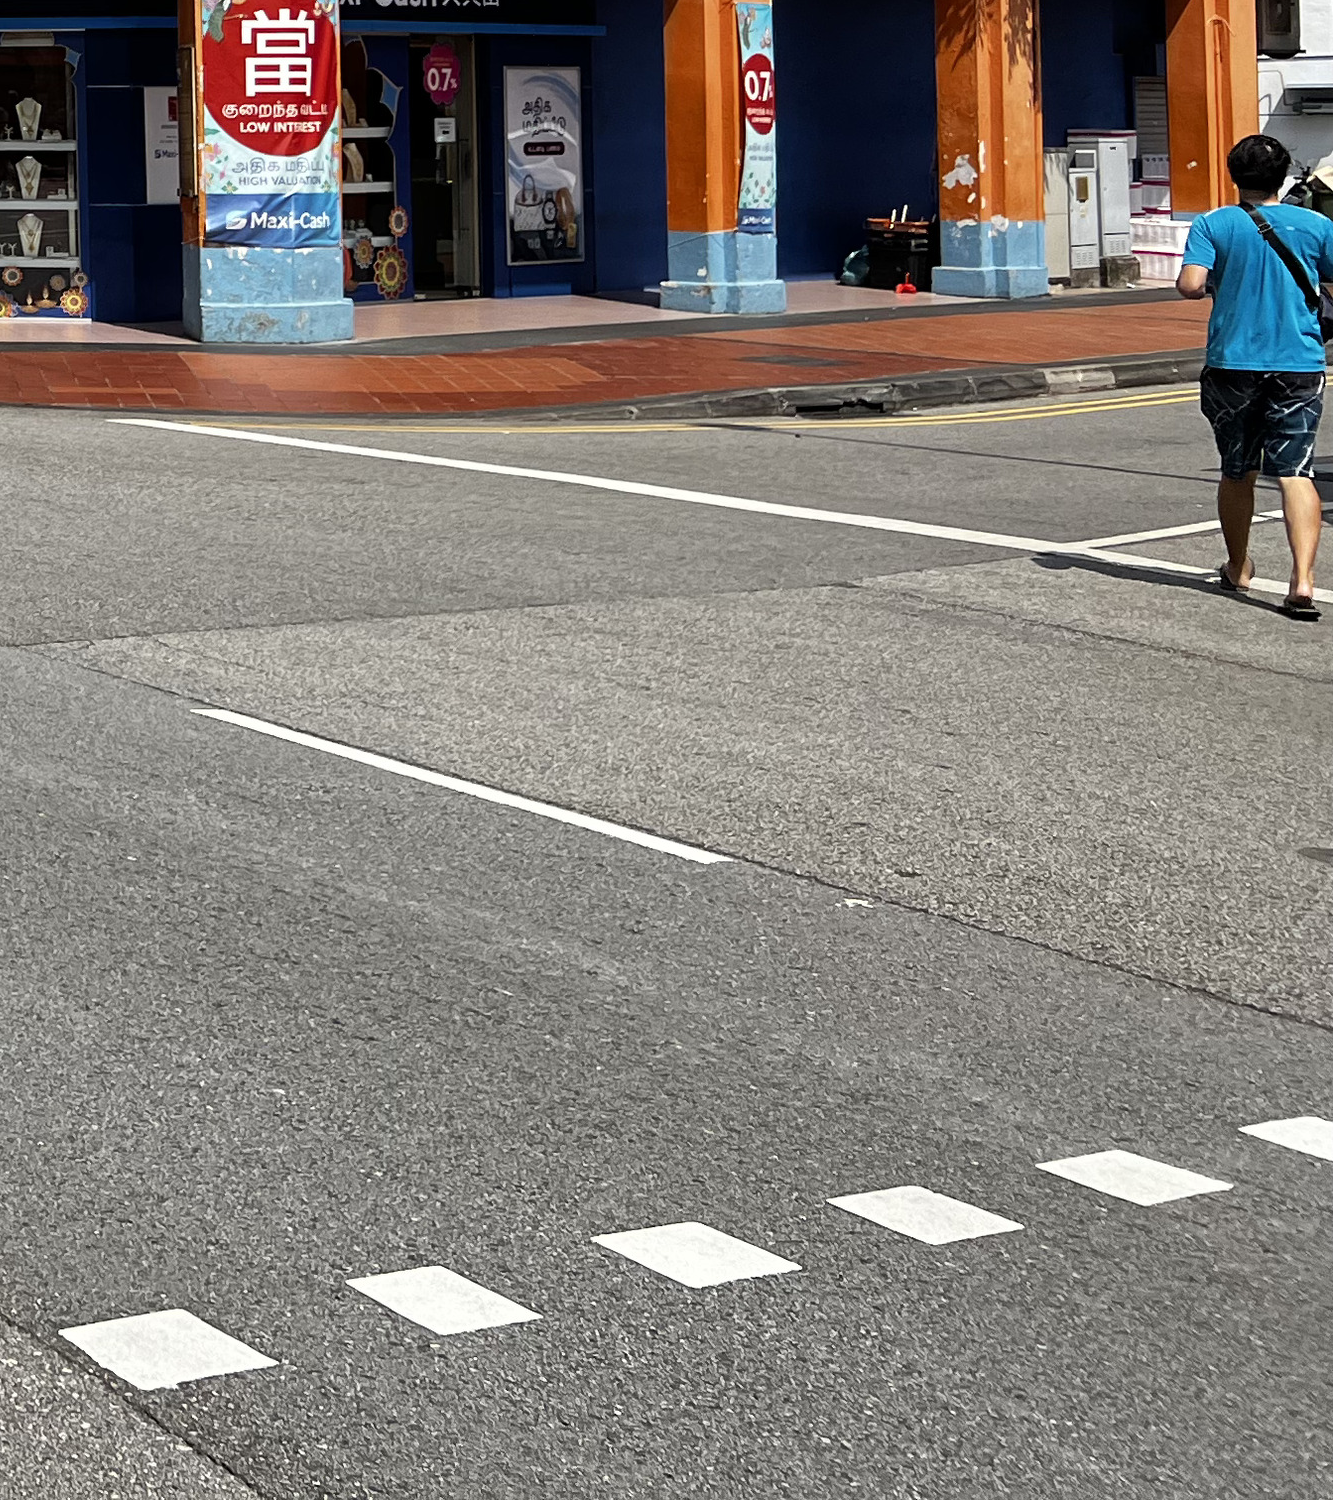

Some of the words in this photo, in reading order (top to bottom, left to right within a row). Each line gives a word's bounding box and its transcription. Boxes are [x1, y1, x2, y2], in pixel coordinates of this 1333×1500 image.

[240, 8, 316, 98] 當
[239, 121, 271, 134] LOW
[238, 176, 268, 186] HIGH
[250, 212, 331, 230] Maxi-Cash
